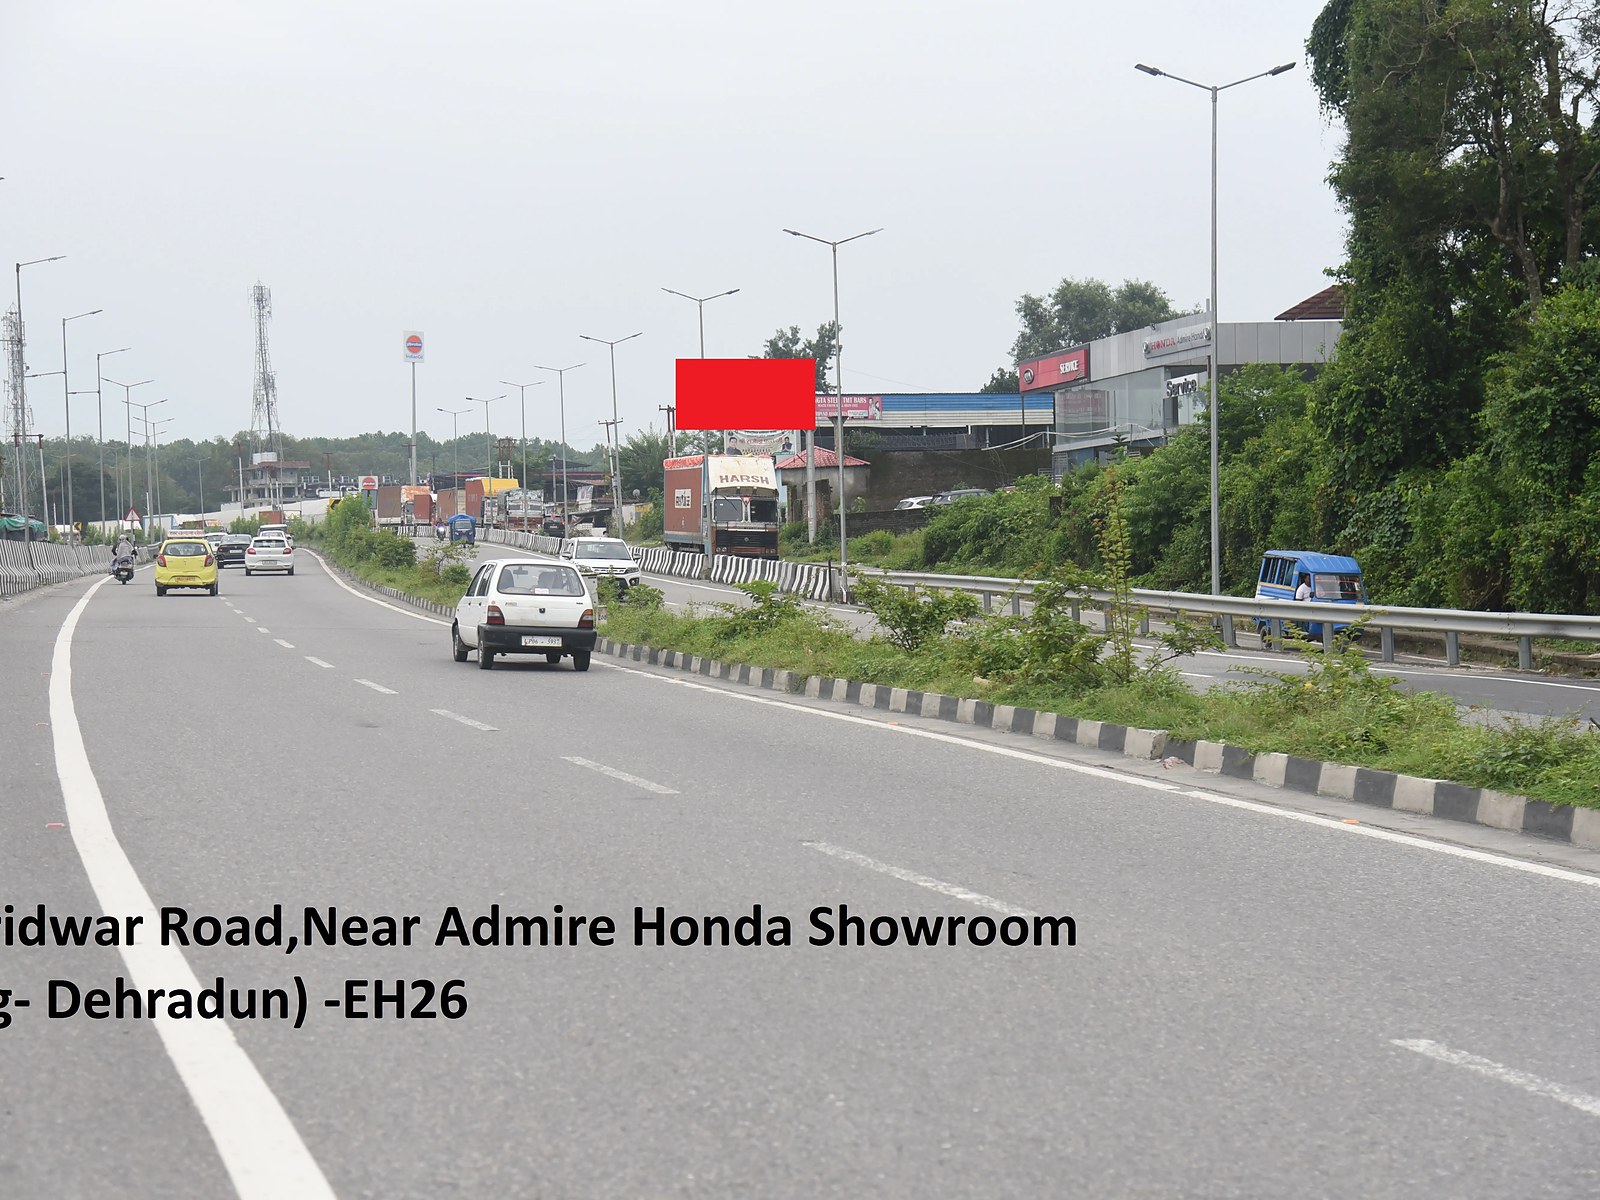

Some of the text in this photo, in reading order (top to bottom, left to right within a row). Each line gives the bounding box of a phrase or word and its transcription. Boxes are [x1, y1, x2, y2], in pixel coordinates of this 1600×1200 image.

[1151, 337, 1176, 350] HONDA
[1059, 360, 1079, 374] SERVICE
[1166, 378, 1197, 397] Service
[719, 474, 770, 485] HARSH
